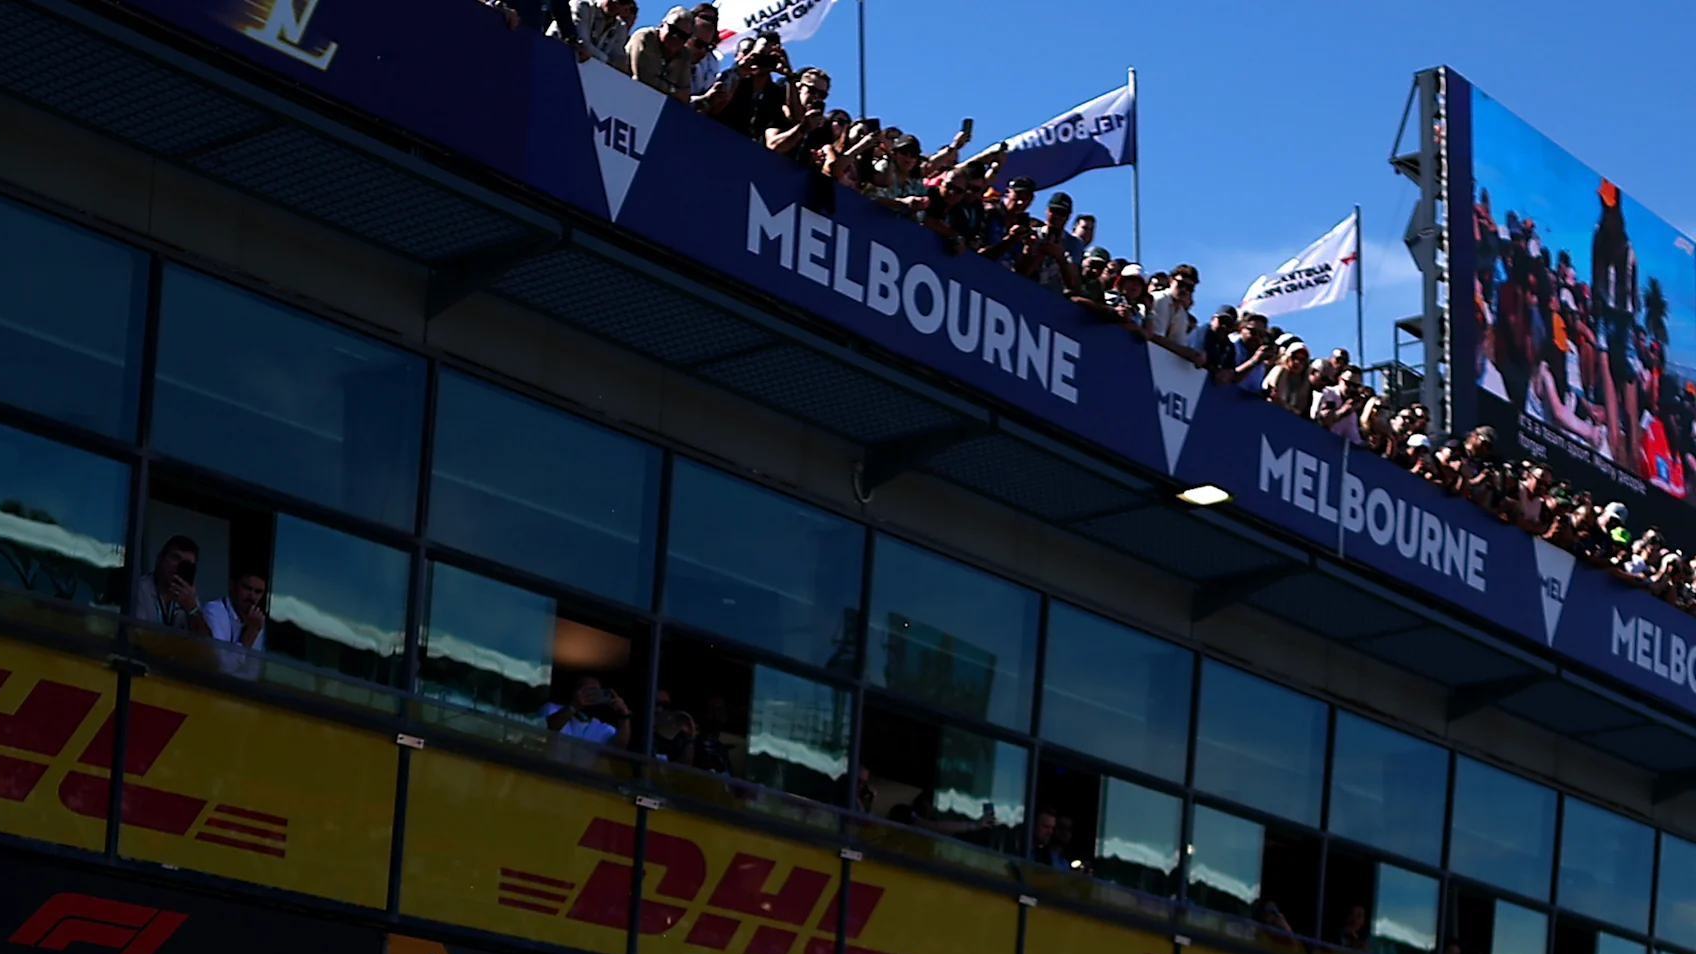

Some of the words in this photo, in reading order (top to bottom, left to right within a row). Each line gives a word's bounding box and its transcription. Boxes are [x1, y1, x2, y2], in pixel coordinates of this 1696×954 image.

[590, 107, 644, 161] MEL
[746, 181, 1082, 405] MELBOURNE
[1156, 386, 1191, 425] MEL
[1258, 432, 1489, 593] MELBOURNE
